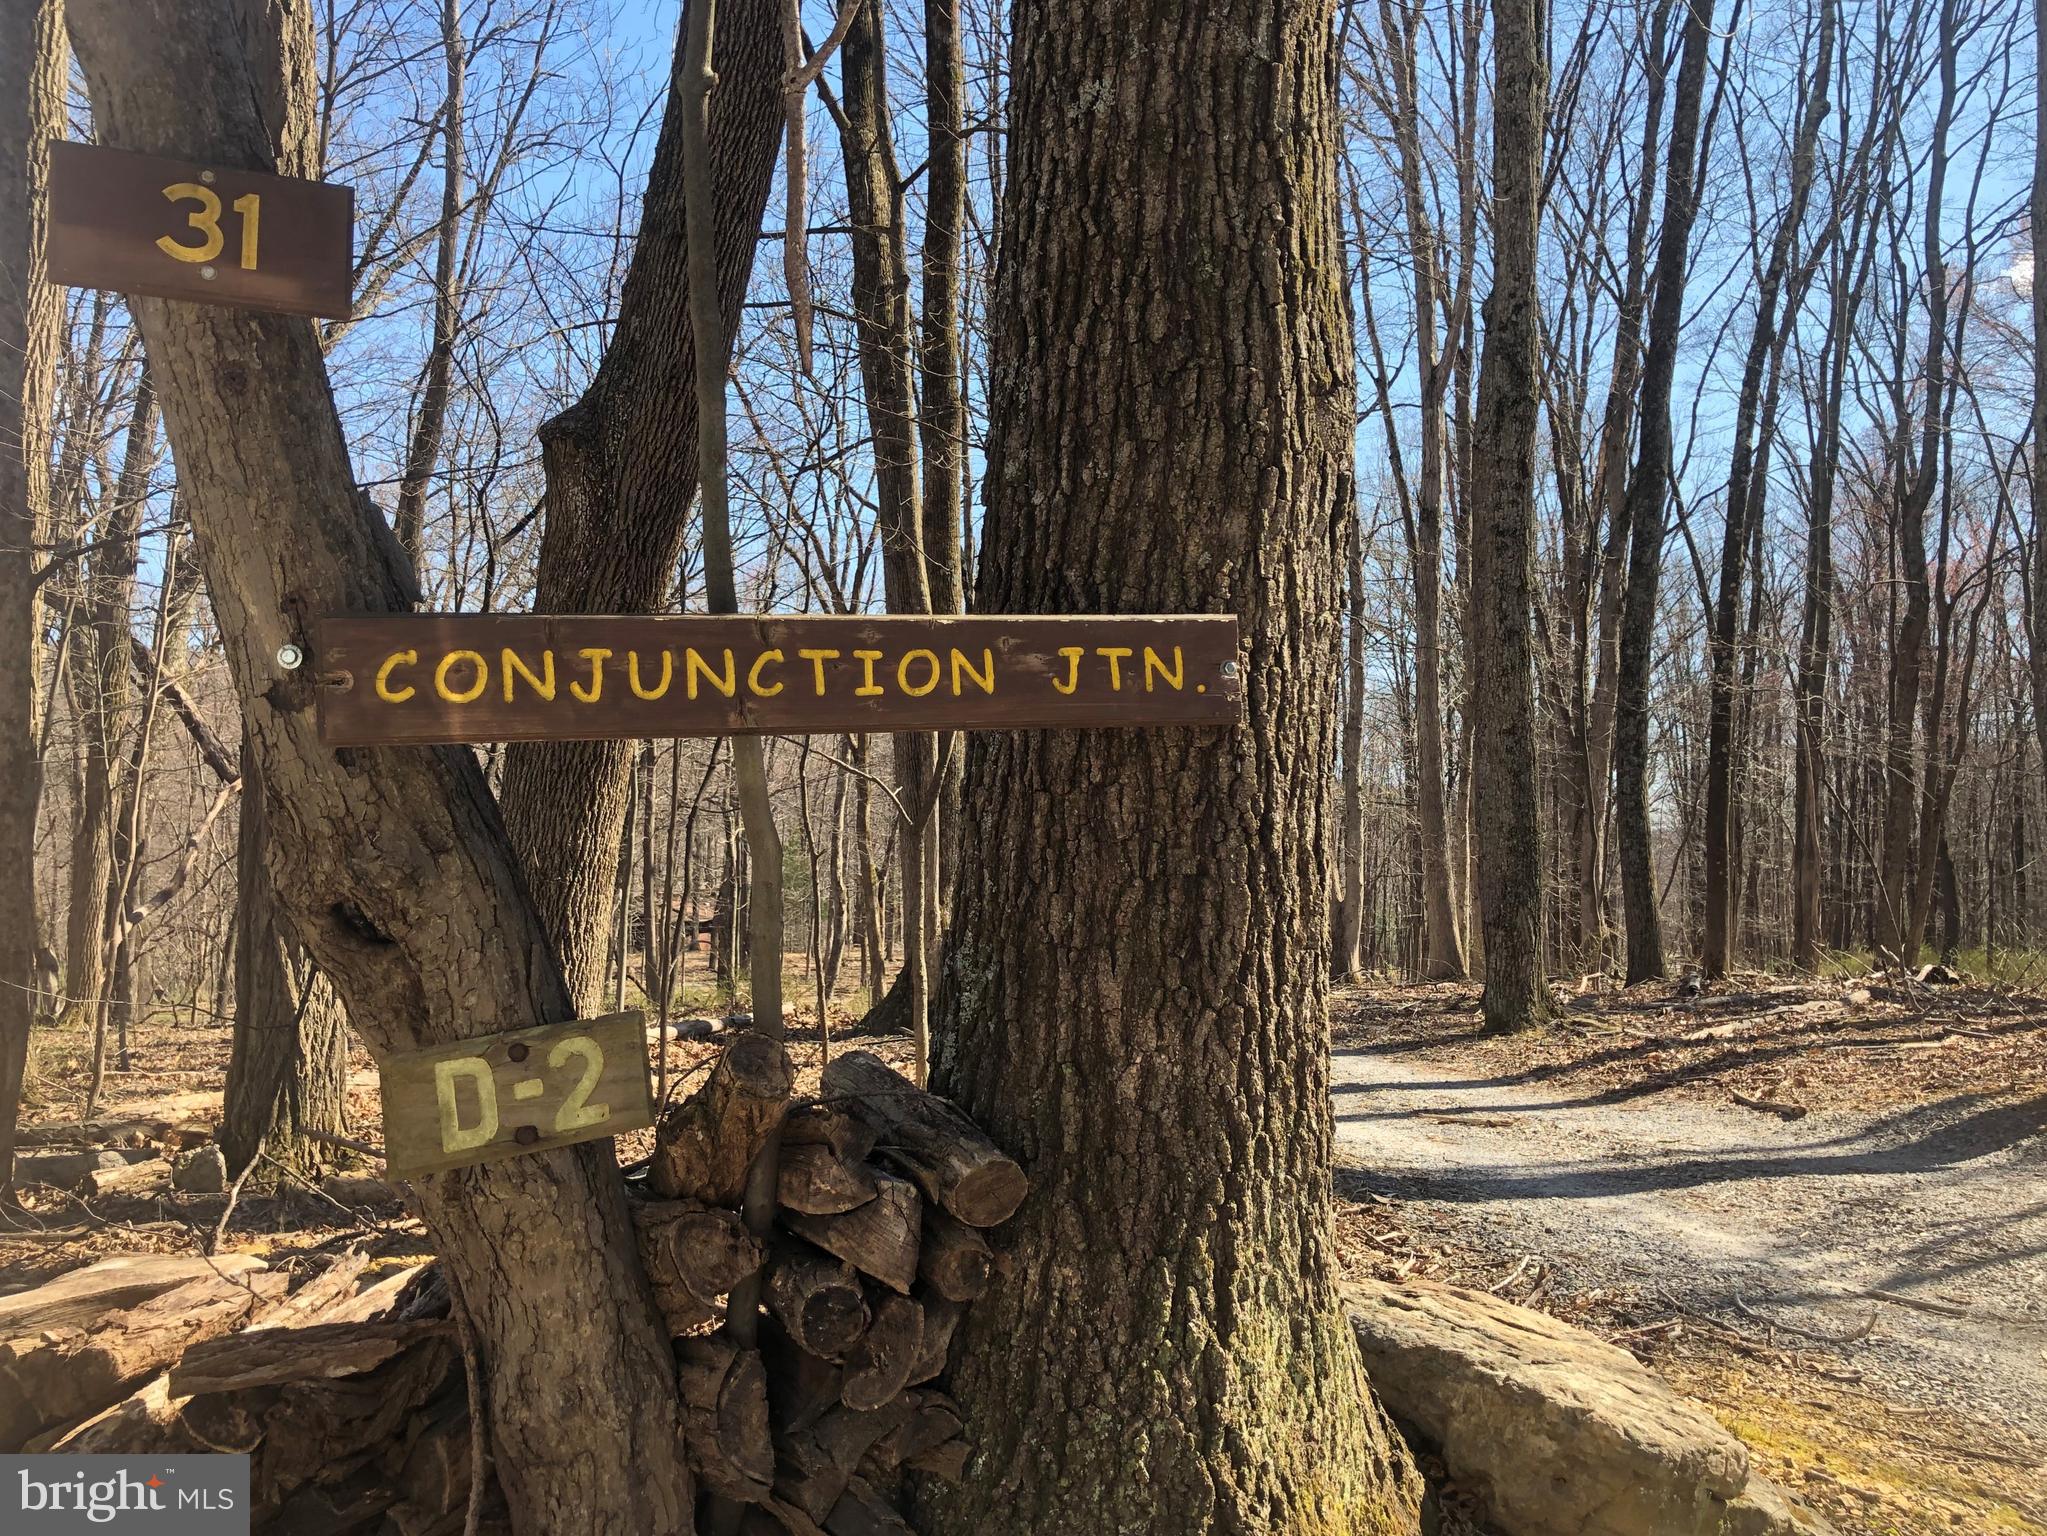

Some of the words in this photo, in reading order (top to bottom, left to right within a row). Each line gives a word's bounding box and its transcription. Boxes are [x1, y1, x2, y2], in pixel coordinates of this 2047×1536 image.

[155, 182, 261, 271] 31
[375, 647, 996, 704] CONJUNCTION
[1051, 645, 1207, 696] JTN.
[434, 1036, 610, 1153] D-2
